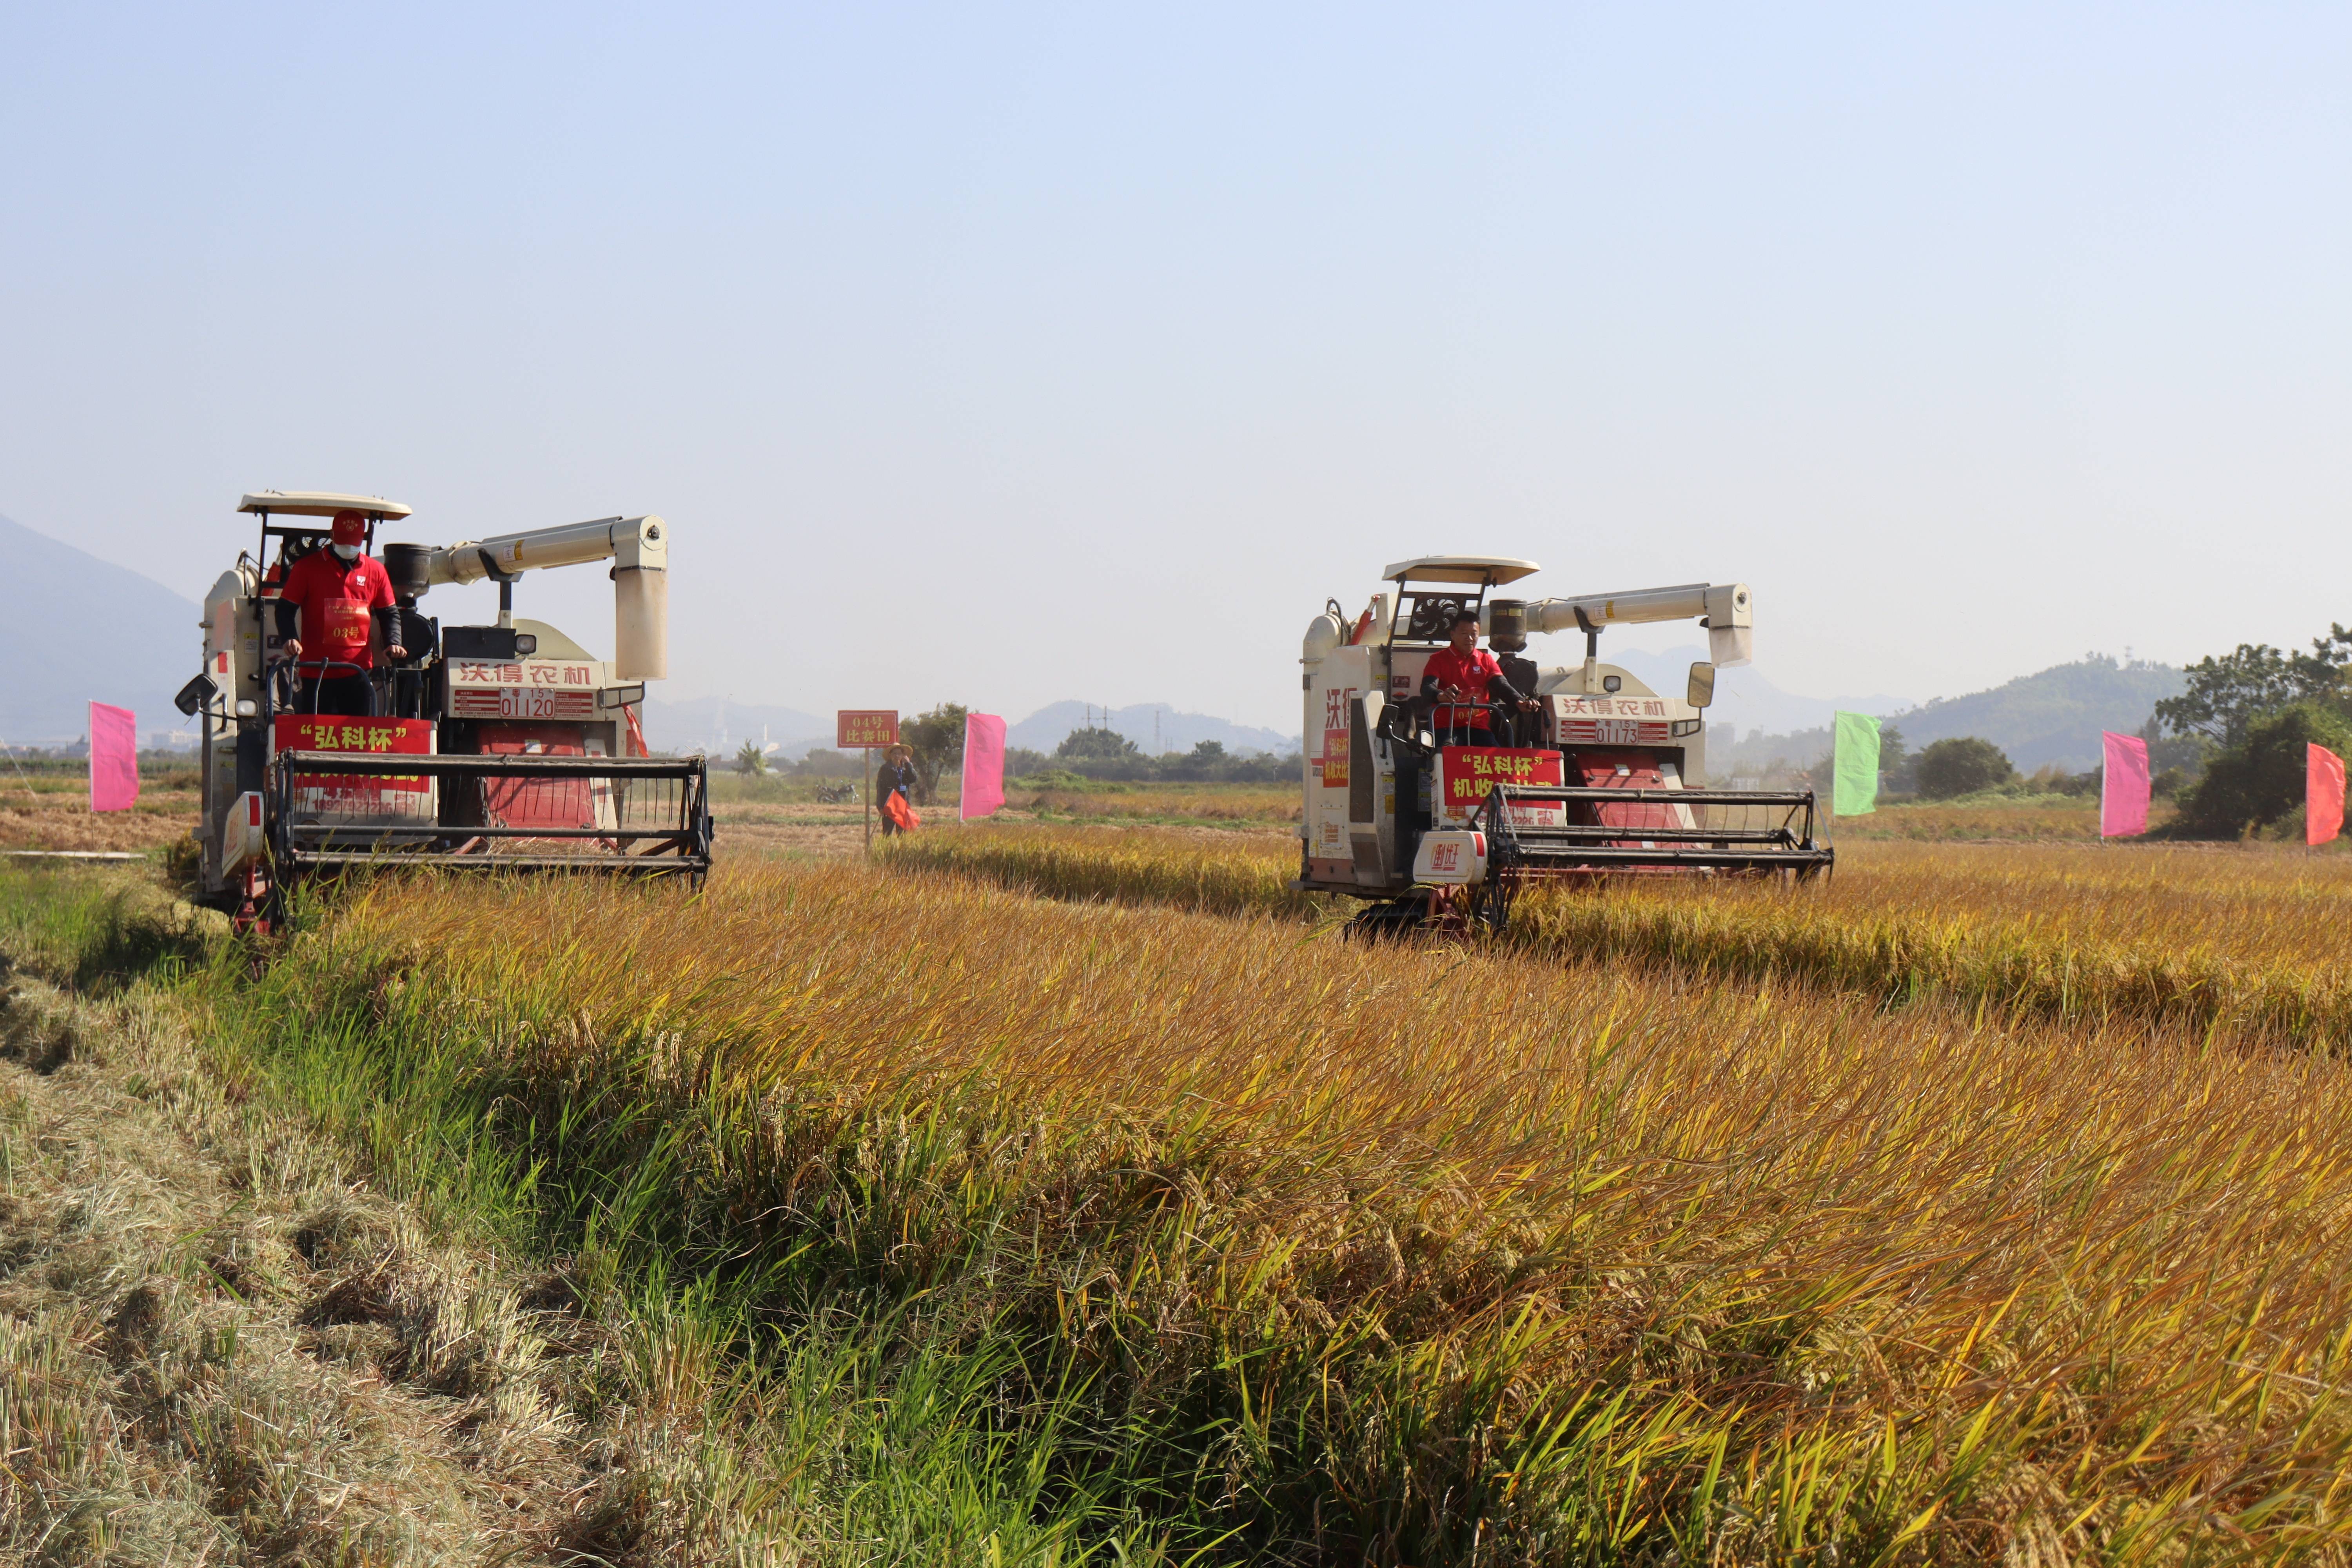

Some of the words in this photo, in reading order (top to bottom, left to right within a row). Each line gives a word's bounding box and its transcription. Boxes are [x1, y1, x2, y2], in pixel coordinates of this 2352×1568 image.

[333, 627, 359, 639] 03号
[460, 662, 591, 685] 沃得农机
[530, 689, 544, 698] 15
[501, 698, 554, 717] 01120
[1563, 698, 1666, 716] 沃得农机
[853, 716, 884, 729] 04号
[301, 724, 407, 751] “弘科杯”
[846, 730, 890, 743] 比赛田
[1597, 728, 1637, 743] 01173
[1325, 760, 1349, 779] 机收大比
[1462, 754, 1543, 776] “弘科杯”
